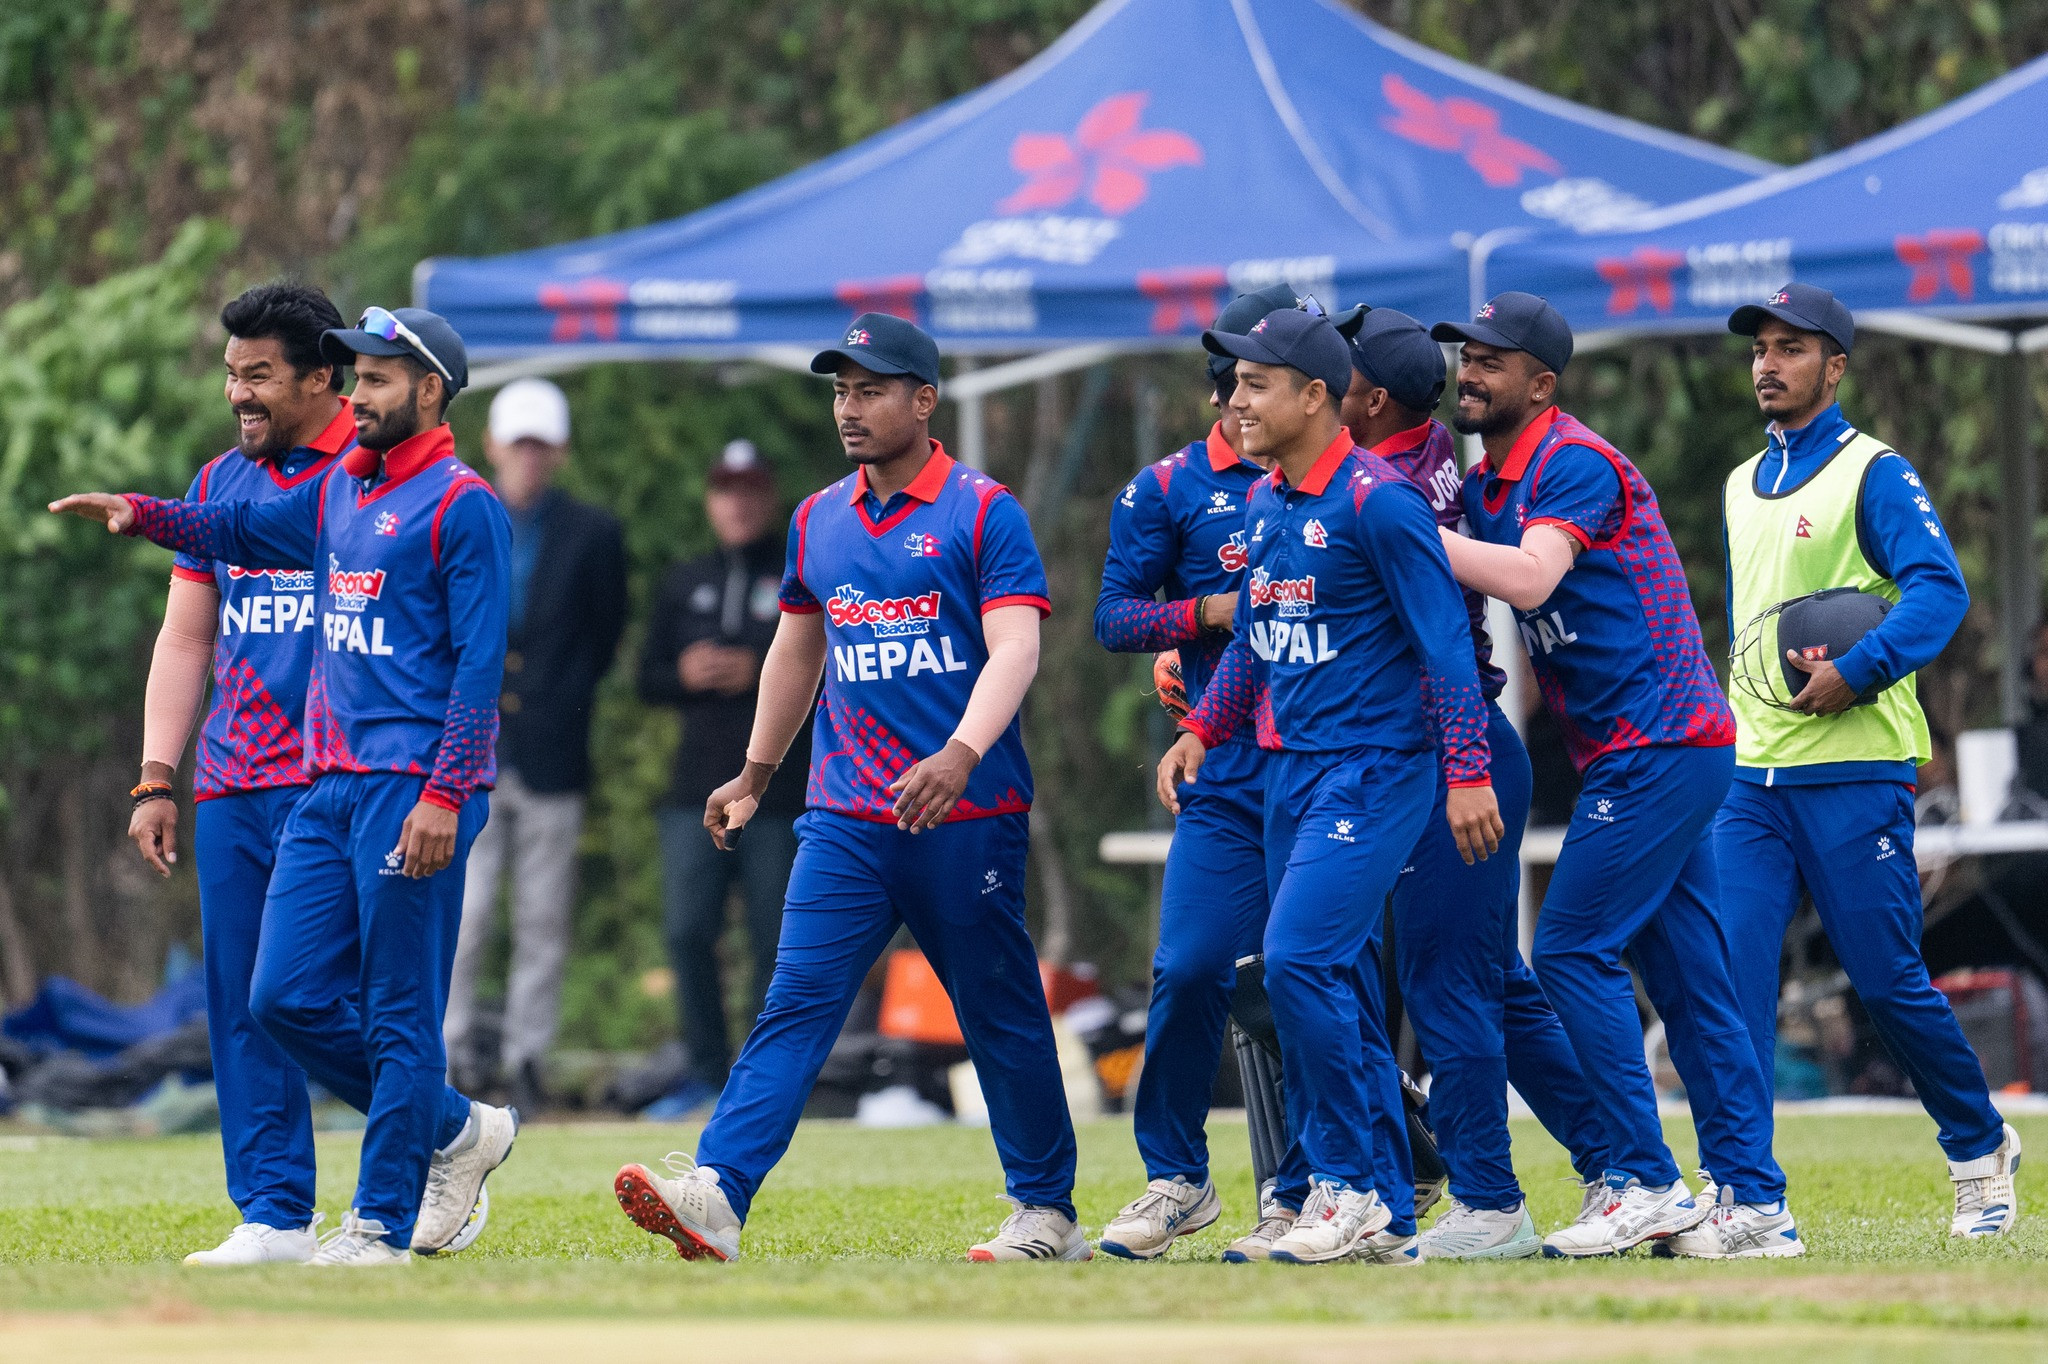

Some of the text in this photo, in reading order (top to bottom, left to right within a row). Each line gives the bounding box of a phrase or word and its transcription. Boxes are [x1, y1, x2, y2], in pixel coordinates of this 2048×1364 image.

[1428, 458, 1462, 512] JOR
[1207, 505, 1237, 515] KELME
[1229, 530, 1246, 548] M
[271, 574, 314, 591] Teache
[1250, 575, 1316, 608] Second
[836, 584, 864, 605] My
[223, 595, 315, 636] NEPA
[827, 590, 941, 627] Second
[323, 612, 393, 655] EPAL
[872, 620, 929, 637] Teacher
[834, 636, 967, 682] NEPAL
[1587, 813, 1615, 822] KELME
[1327, 832, 1355, 843] KELME
